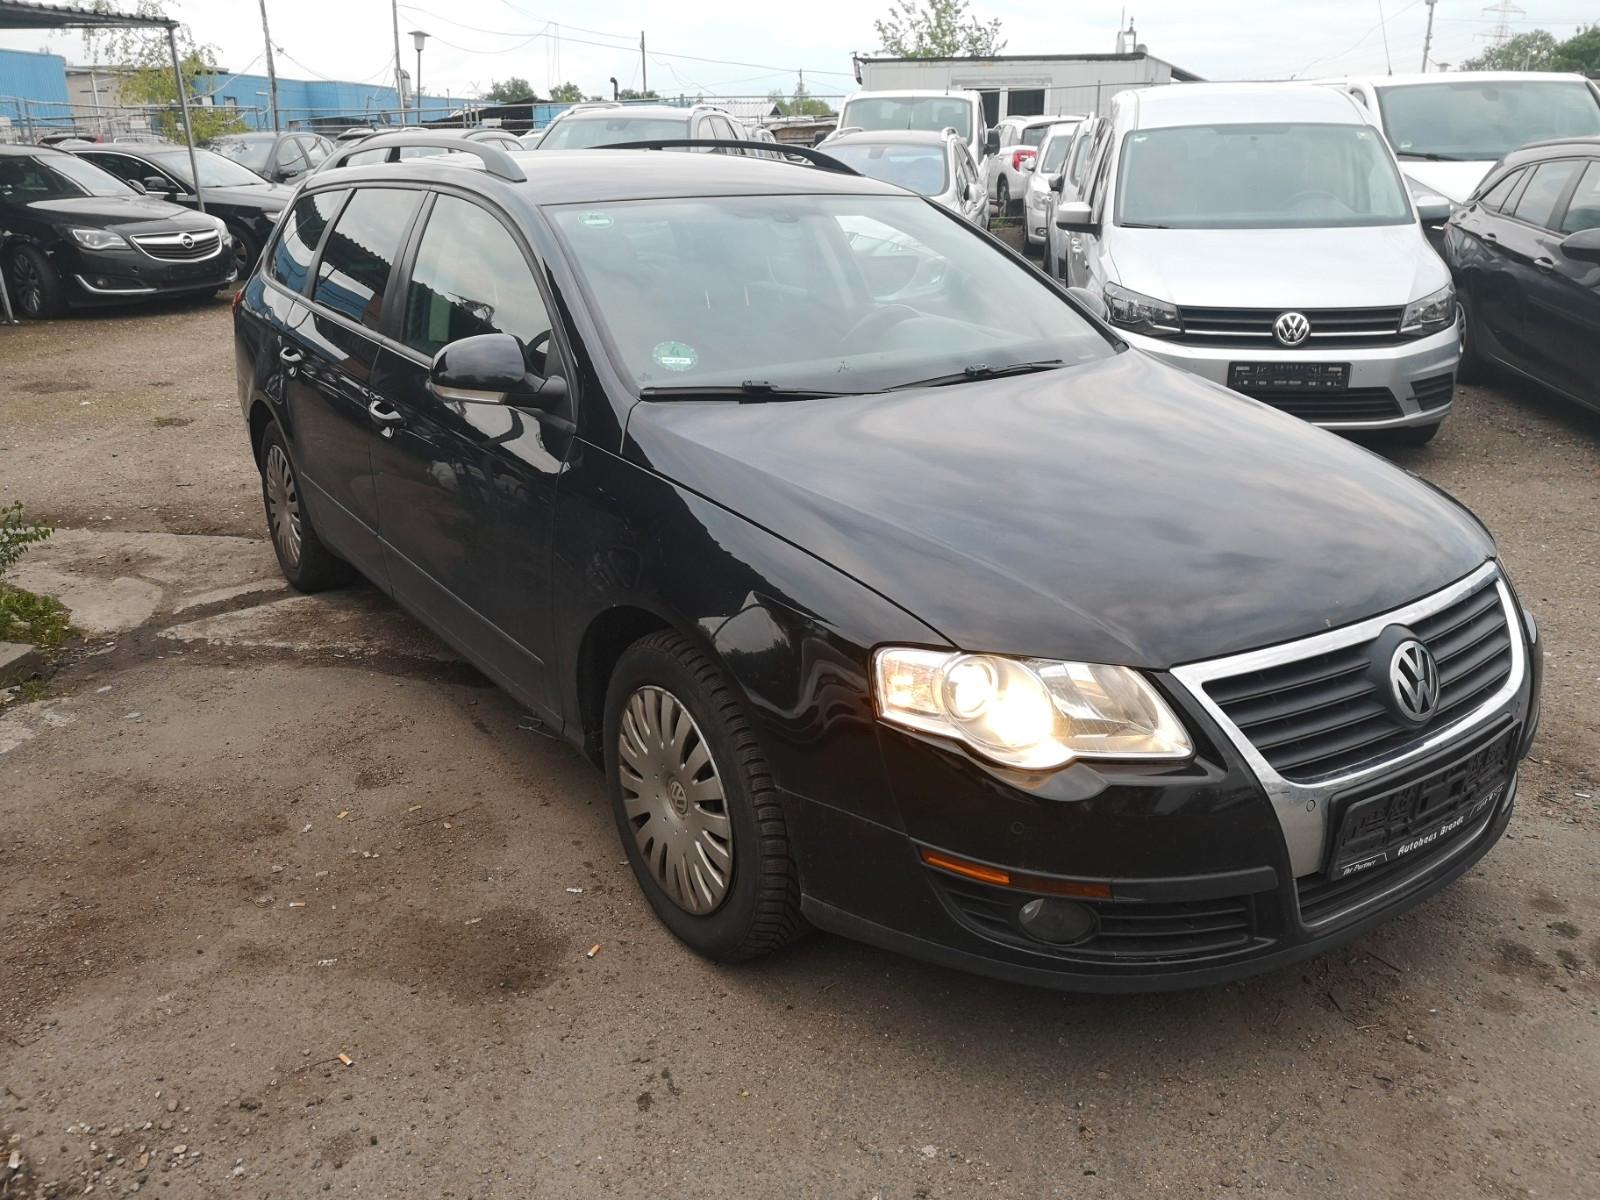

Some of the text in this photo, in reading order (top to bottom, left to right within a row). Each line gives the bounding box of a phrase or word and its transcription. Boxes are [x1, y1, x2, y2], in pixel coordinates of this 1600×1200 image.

[1276, 312, 1310, 345] VW
[1390, 640, 1440, 722] VW
[1397, 832, 1438, 857] Autohaus
